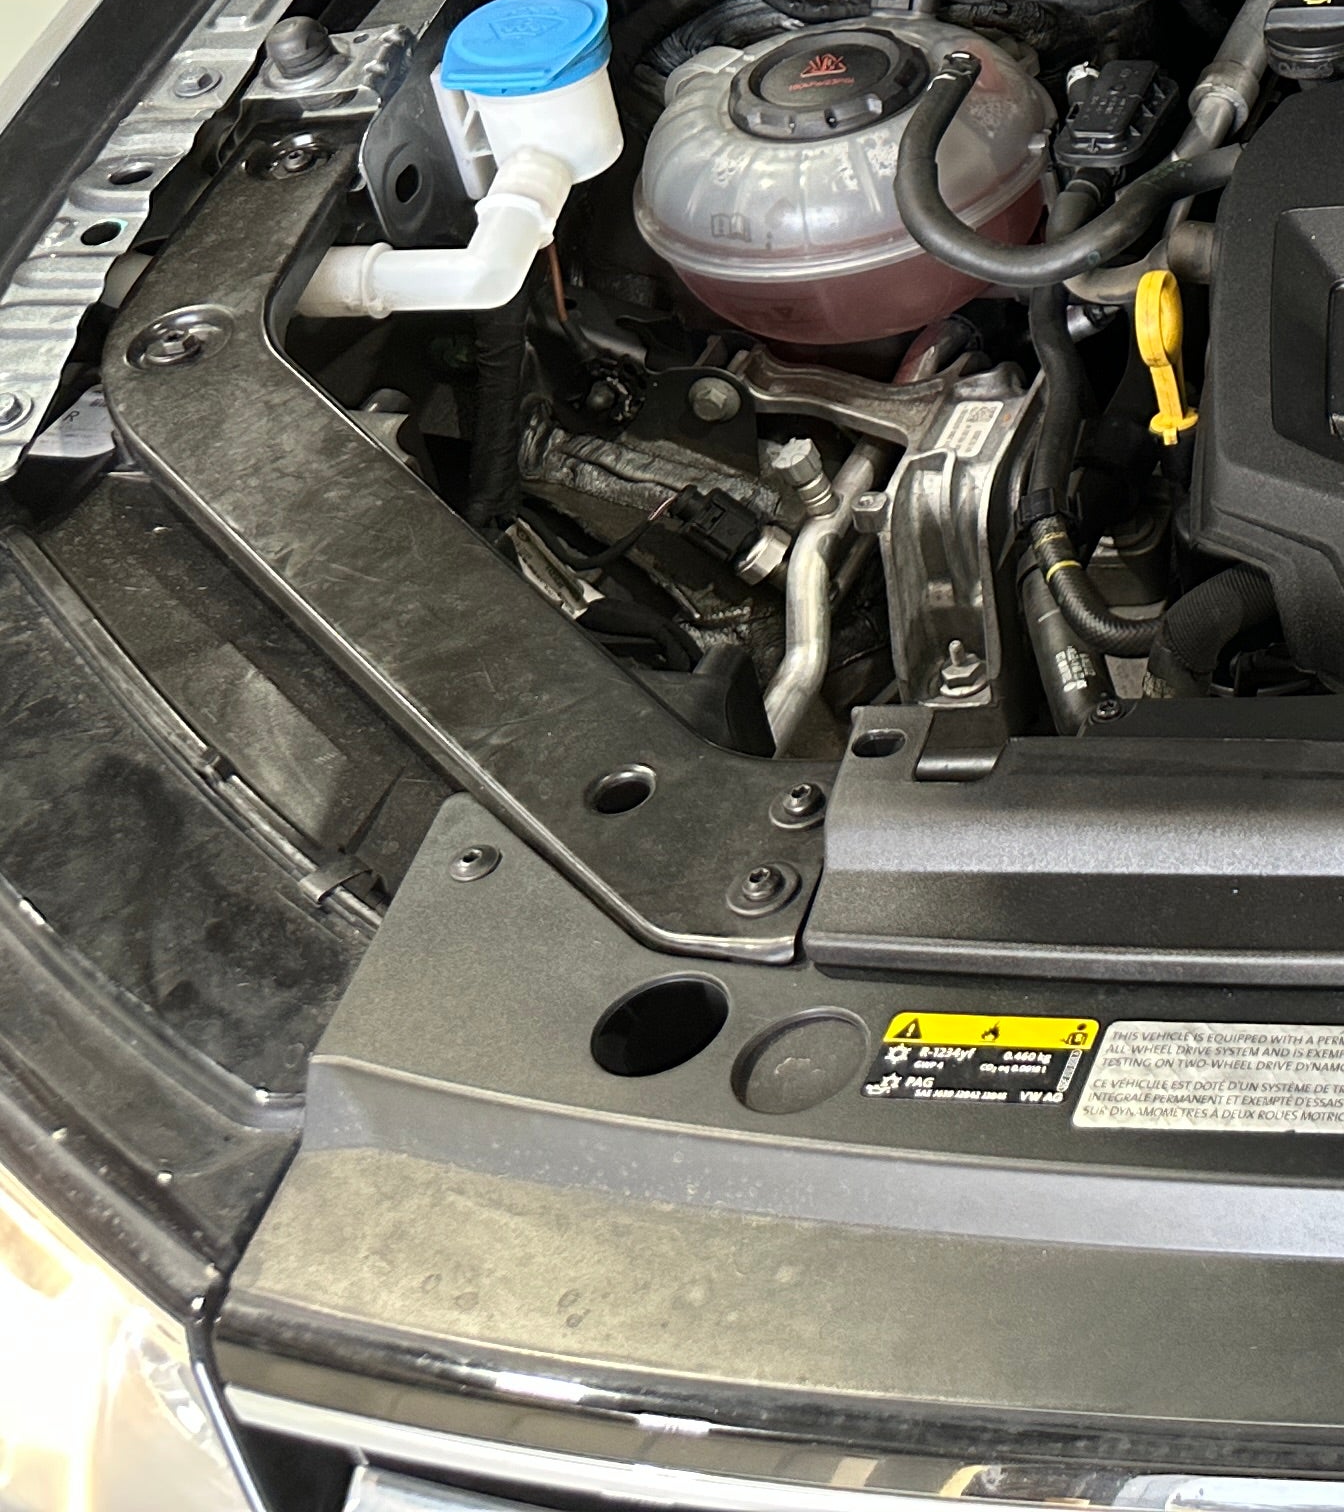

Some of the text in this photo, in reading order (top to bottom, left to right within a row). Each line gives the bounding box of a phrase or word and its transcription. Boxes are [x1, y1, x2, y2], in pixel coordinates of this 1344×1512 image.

[1112, 1032, 1139, 1041] THIS
[1141, 1032, 1189, 1042] VEHICLE
[1193, 1033, 1204, 1042] IS
[1207, 1034, 1268, 1043] EQUIPPED
[1270, 1035, 1302, 1045] WITH
[1306, 1036, 1314, 1046] A
[919, 1047, 977, 1062] R-1234yf
[1037, 1053, 1052, 1064] kg
[1176, 1046, 1212, 1055] DRIVE
[1215, 1047, 1260, 1057] SYSTEM
[1262, 1048, 1290, 1057] AND
[1292, 1049, 1303, 1058] IS
[1102, 1058, 1152, 1067] TESTING
[1156, 1058, 1174, 1068] ON
[1177, 1059, 1253, 1070] TWO-WHEEL
[1255, 1061, 1292, 1071] DRIVE
[905, 1077, 935, 1087] PAG
[1093, 1079, 1107, 1088] CE
[1111, 1078, 1170, 1090] VÉHICULE
[1171, 1081, 1190, 1090] EST
[1194, 1079, 1225, 1090] DOTÉ
[1228, 1081, 1259, 1091] D'UN
[1262, 1081, 1310, 1093] SYSTÈME
[1313, 1084, 1330, 1094] DE
[1020, 1091, 1064, 1102] VW AG
[1154, 1093, 1222, 1104] PERMANENT
[1226, 1095, 1239, 1104] ET
[1241, 1095, 1292, 1106] EXEMPTÉ
[1295, 1097, 1344, 1107] D'ESSAIS
[1222, 1109, 1256, 1119] DEUX
[1258, 1110, 1298, 1120] ROUES
